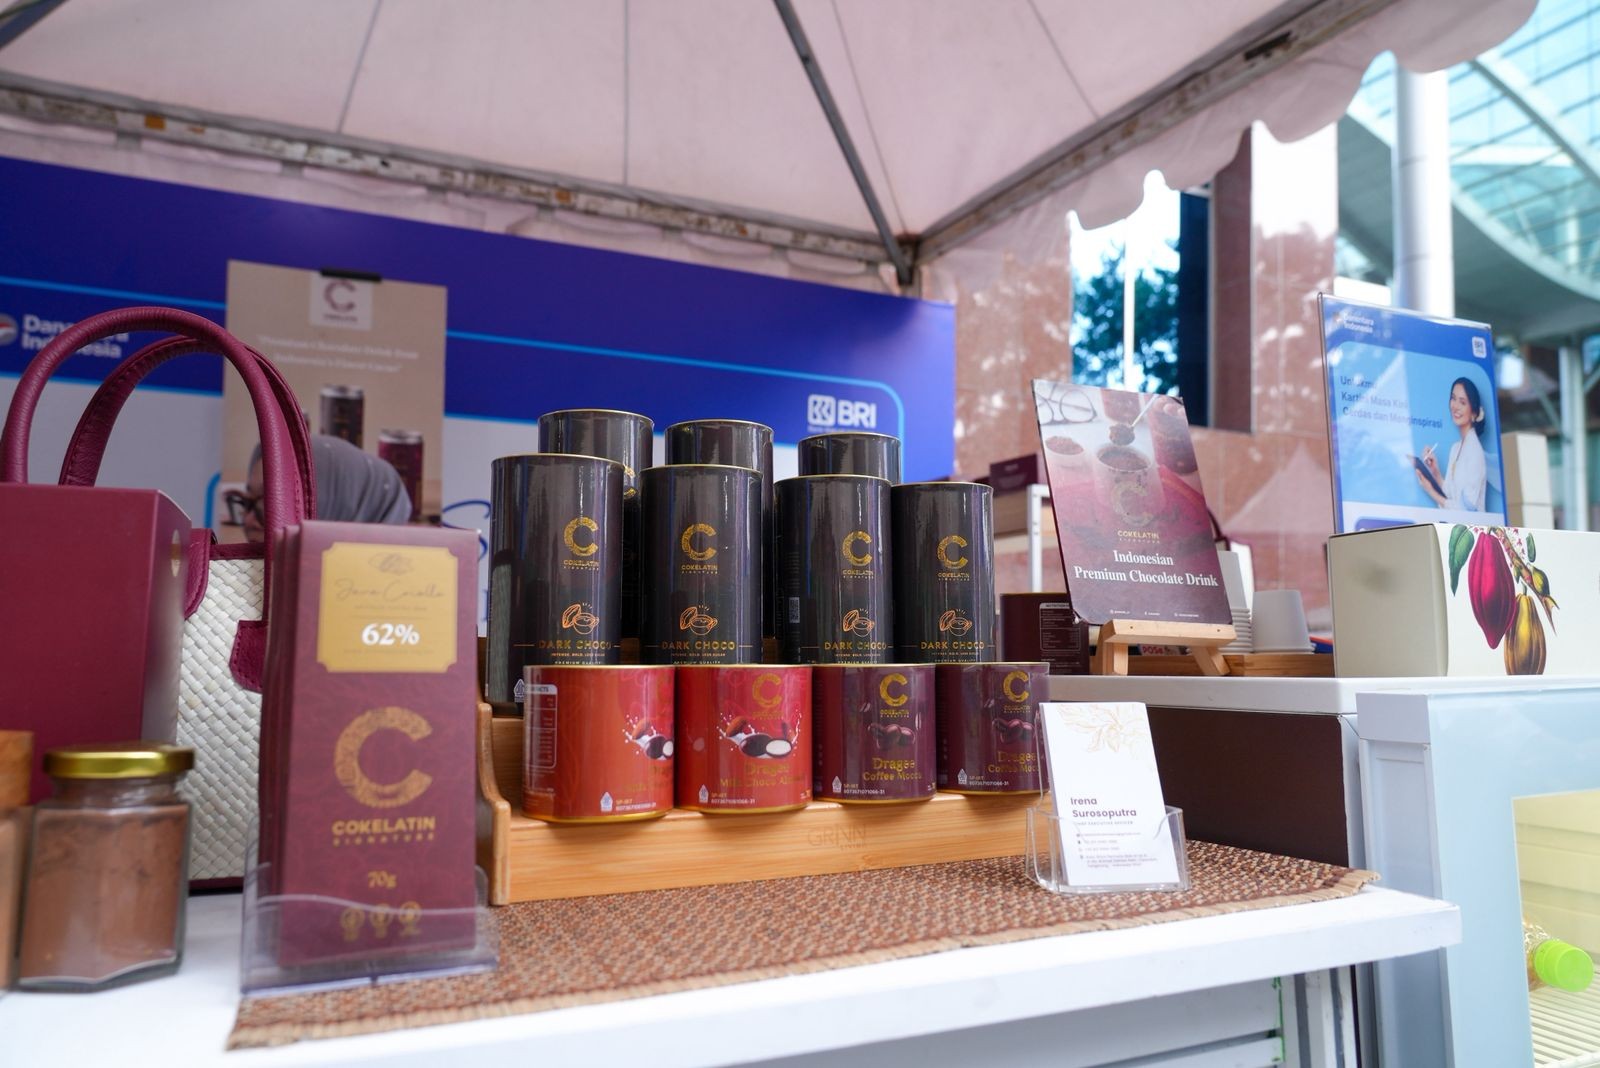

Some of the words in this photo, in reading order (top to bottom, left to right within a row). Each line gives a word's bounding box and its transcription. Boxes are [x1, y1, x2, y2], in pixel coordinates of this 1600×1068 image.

[838, 399, 878, 428] BRI
[1117, 530, 1160, 539] COKELATIN
[1113, 550, 1174, 566] Indonesian
[1074, 565, 1127, 581] Premium
[1129, 569, 1183, 585] Chocolate
[1185, 573, 1219, 587] Drink
[361, 623, 420, 646] 62%
[539, 640, 571, 650] DARK
[662, 640, 690, 650] DARK
[694, 641, 735, 650] CHOCO
[824, 641, 853, 650] DARK
[857, 641, 887, 650] CHOCO
[920, 641, 948, 650] DARK
[952, 641, 985, 650] CHOCO
[334, 706, 433, 809] C
[863, 772, 895, 781] Coffee
[1070, 797, 1097, 806] Irena
[1072, 809, 1137, 820] Surosoputra
[332, 816, 436, 836] COKELATIN
[367, 870, 397, 889] 70g
